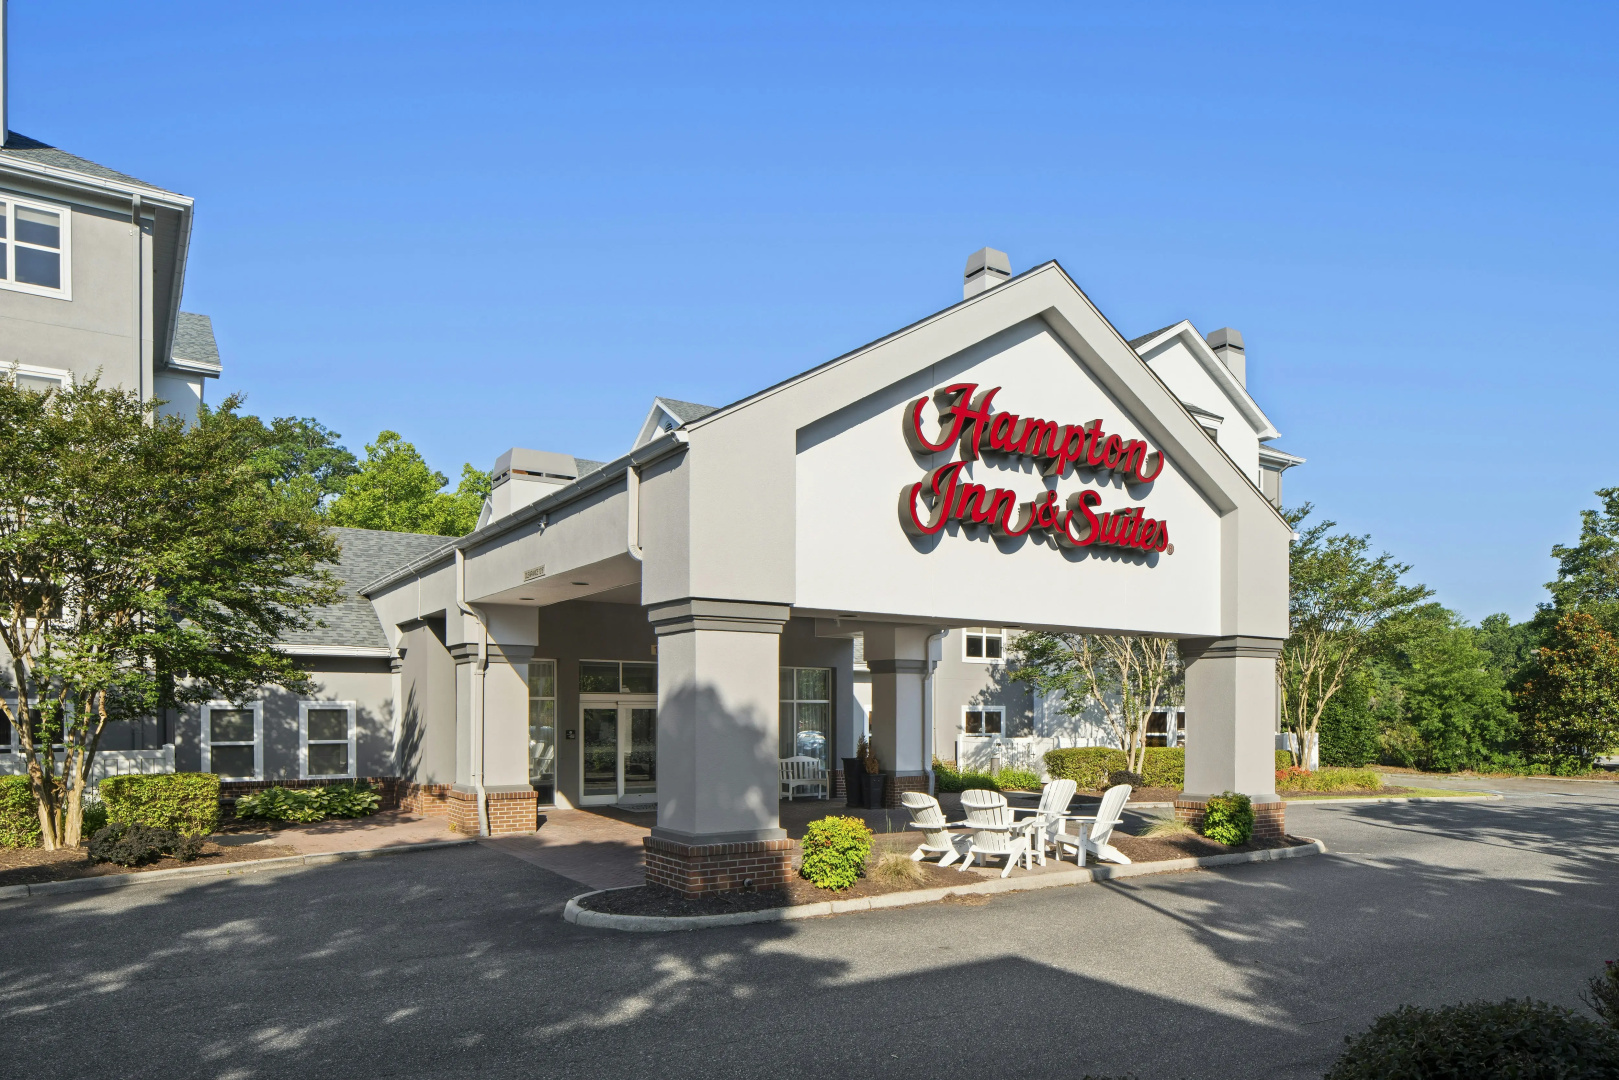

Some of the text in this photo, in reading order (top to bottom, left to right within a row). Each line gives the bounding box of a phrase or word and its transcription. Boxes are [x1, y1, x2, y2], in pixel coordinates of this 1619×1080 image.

[905, 383, 1164, 483] Hampton
[901, 461, 1036, 537] Inn
[1037, 490, 1066, 533] &
